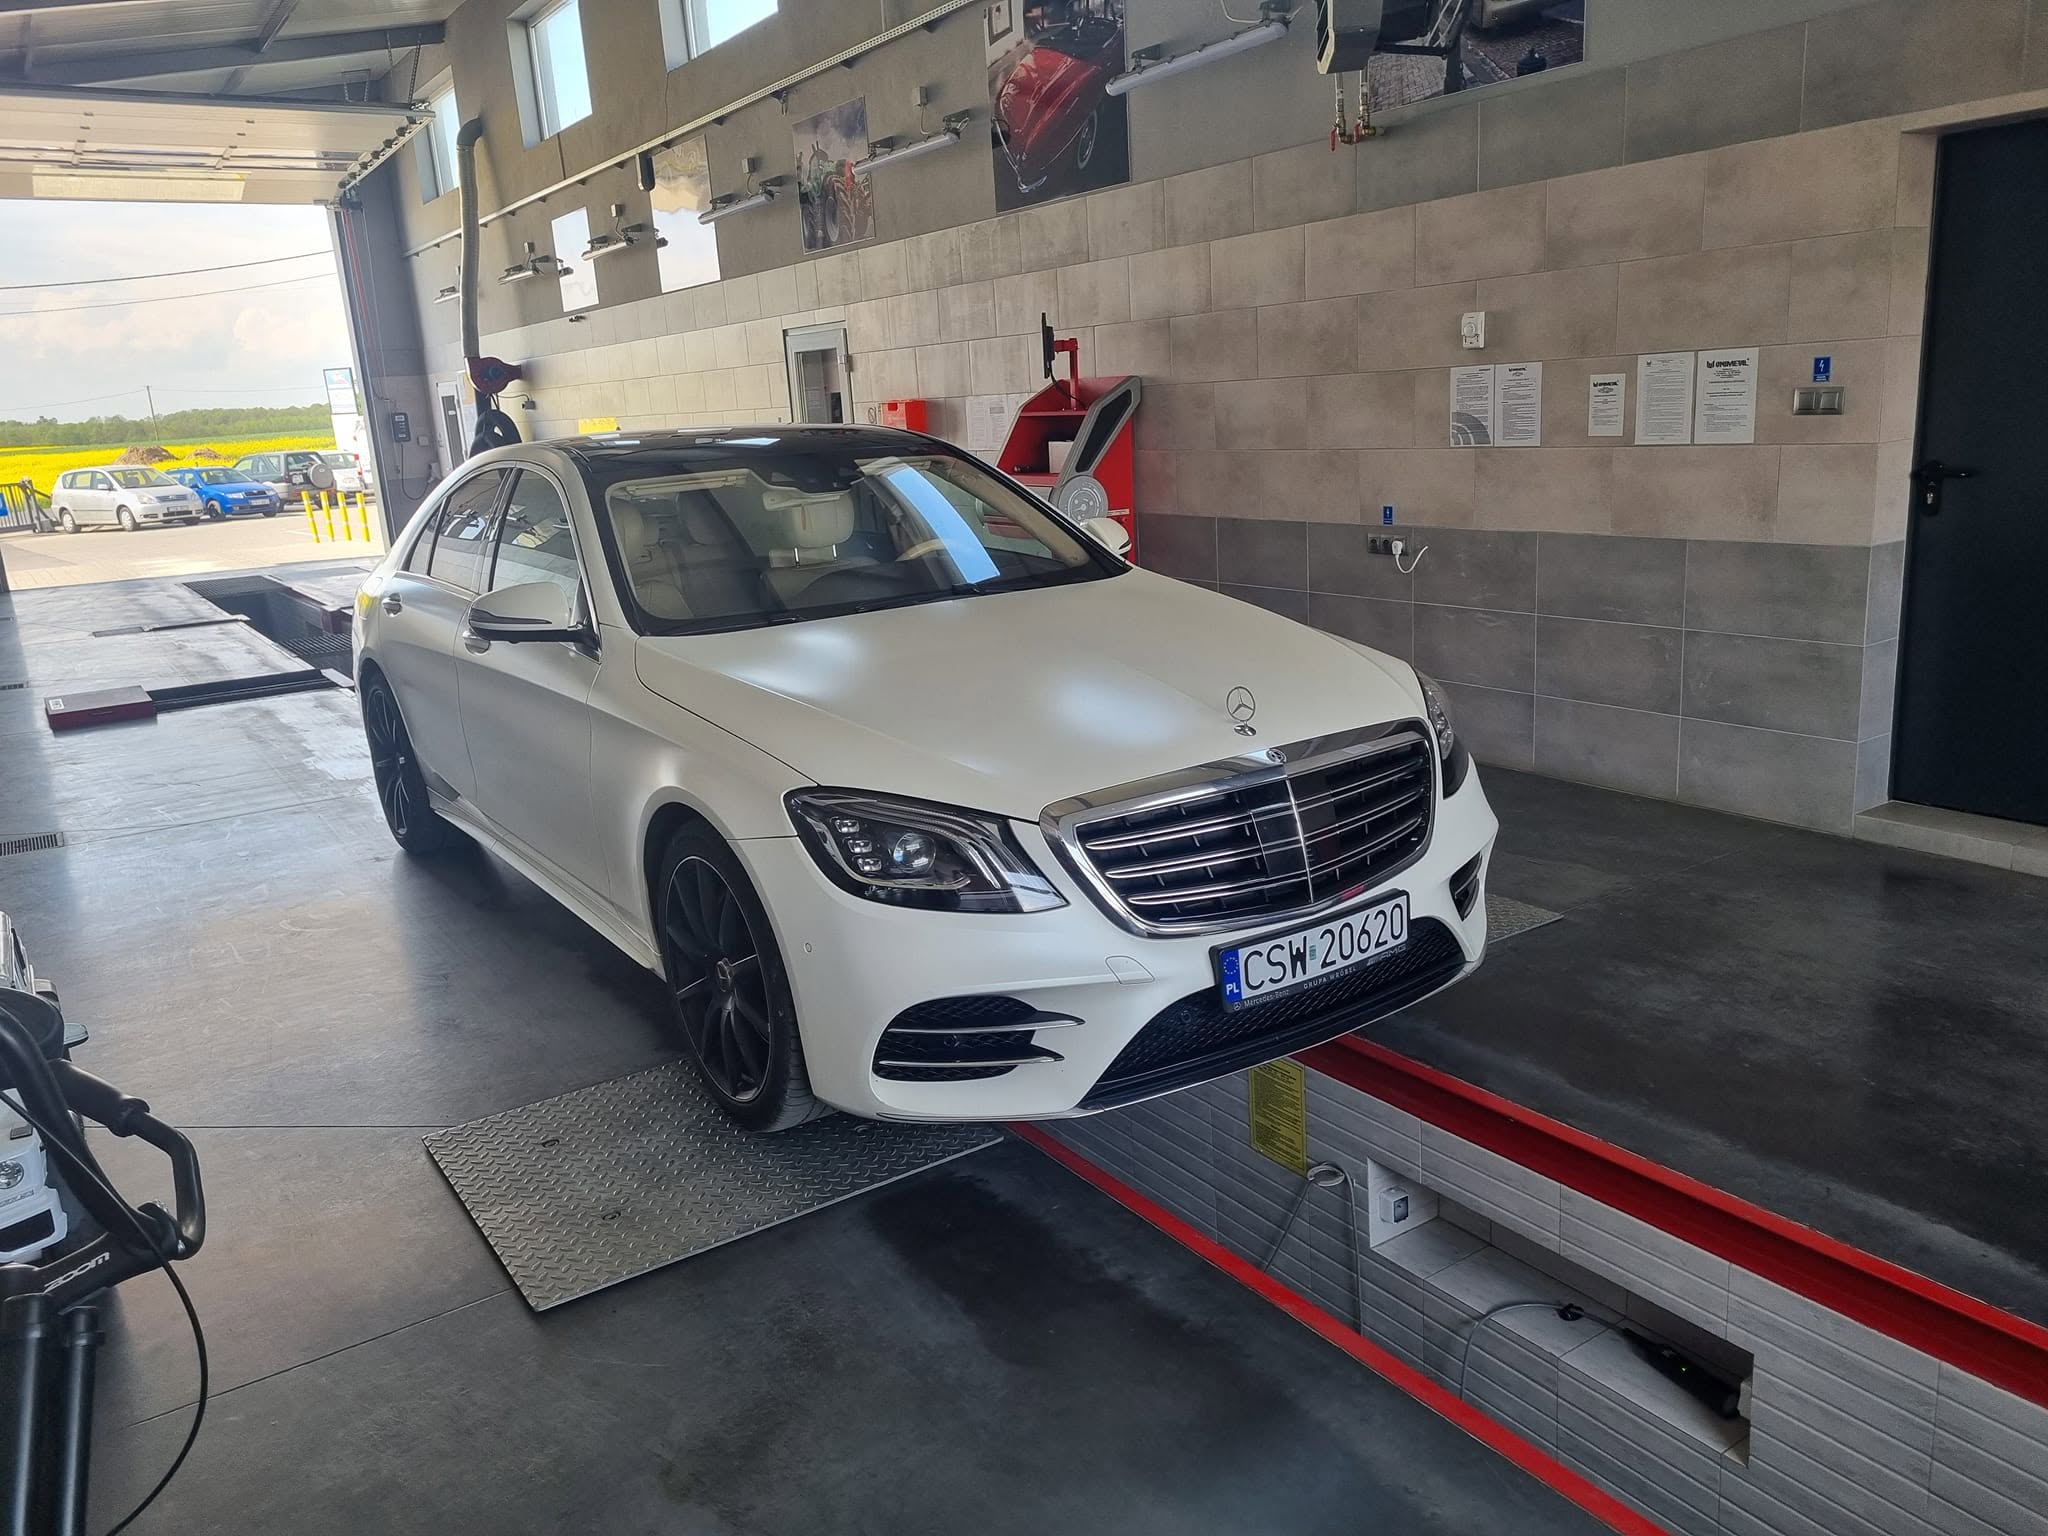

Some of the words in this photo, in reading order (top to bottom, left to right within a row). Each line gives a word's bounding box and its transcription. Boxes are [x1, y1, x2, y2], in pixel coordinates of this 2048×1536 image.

[1244, 935, 1308, 991] CSW
[1319, 903, 1404, 970] 20620
[1380, 943, 1407, 959] AMG
[1226, 982, 1240, 996] PL
[1303, 977, 1327, 990] GRUPA
[1243, 989, 1290, 1009] Mercedes-Benz
